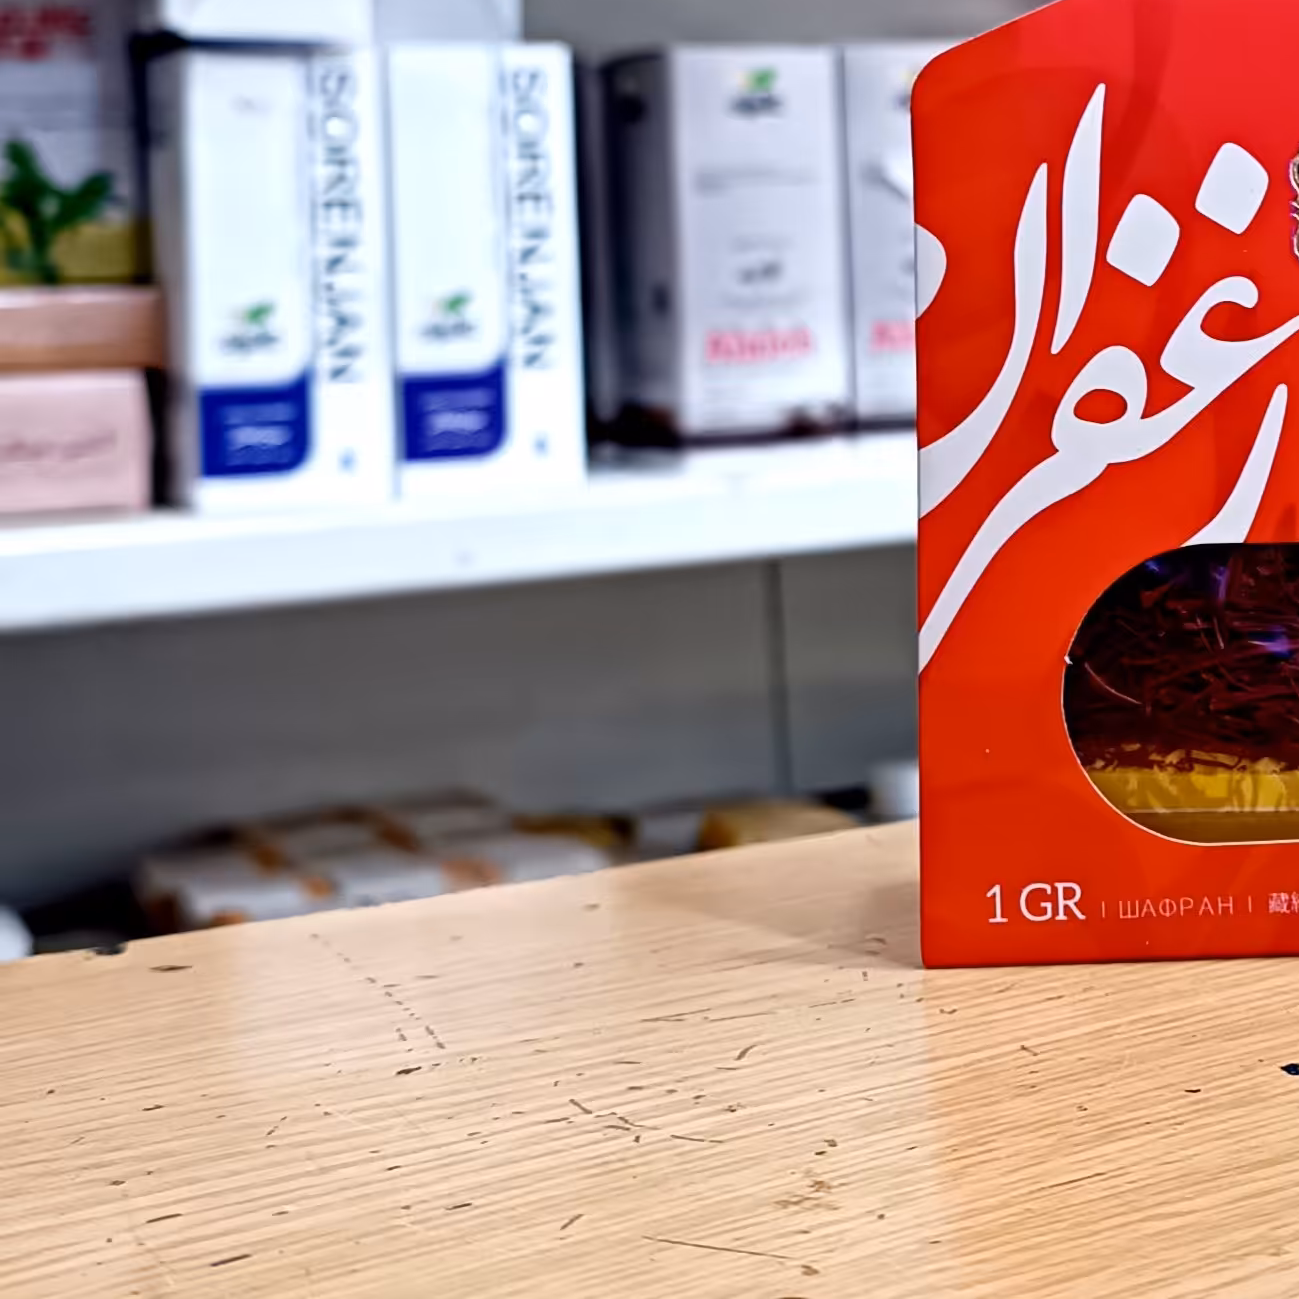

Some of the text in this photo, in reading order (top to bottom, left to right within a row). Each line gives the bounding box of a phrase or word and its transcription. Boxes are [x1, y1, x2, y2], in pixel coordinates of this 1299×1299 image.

[318, 68, 365, 383] SORENJAN
[511, 67, 557, 369] SORENJAN
[985, 881, 1087, 924] 1 GR
[1118, 896, 1235, 919] ШАФРАН
